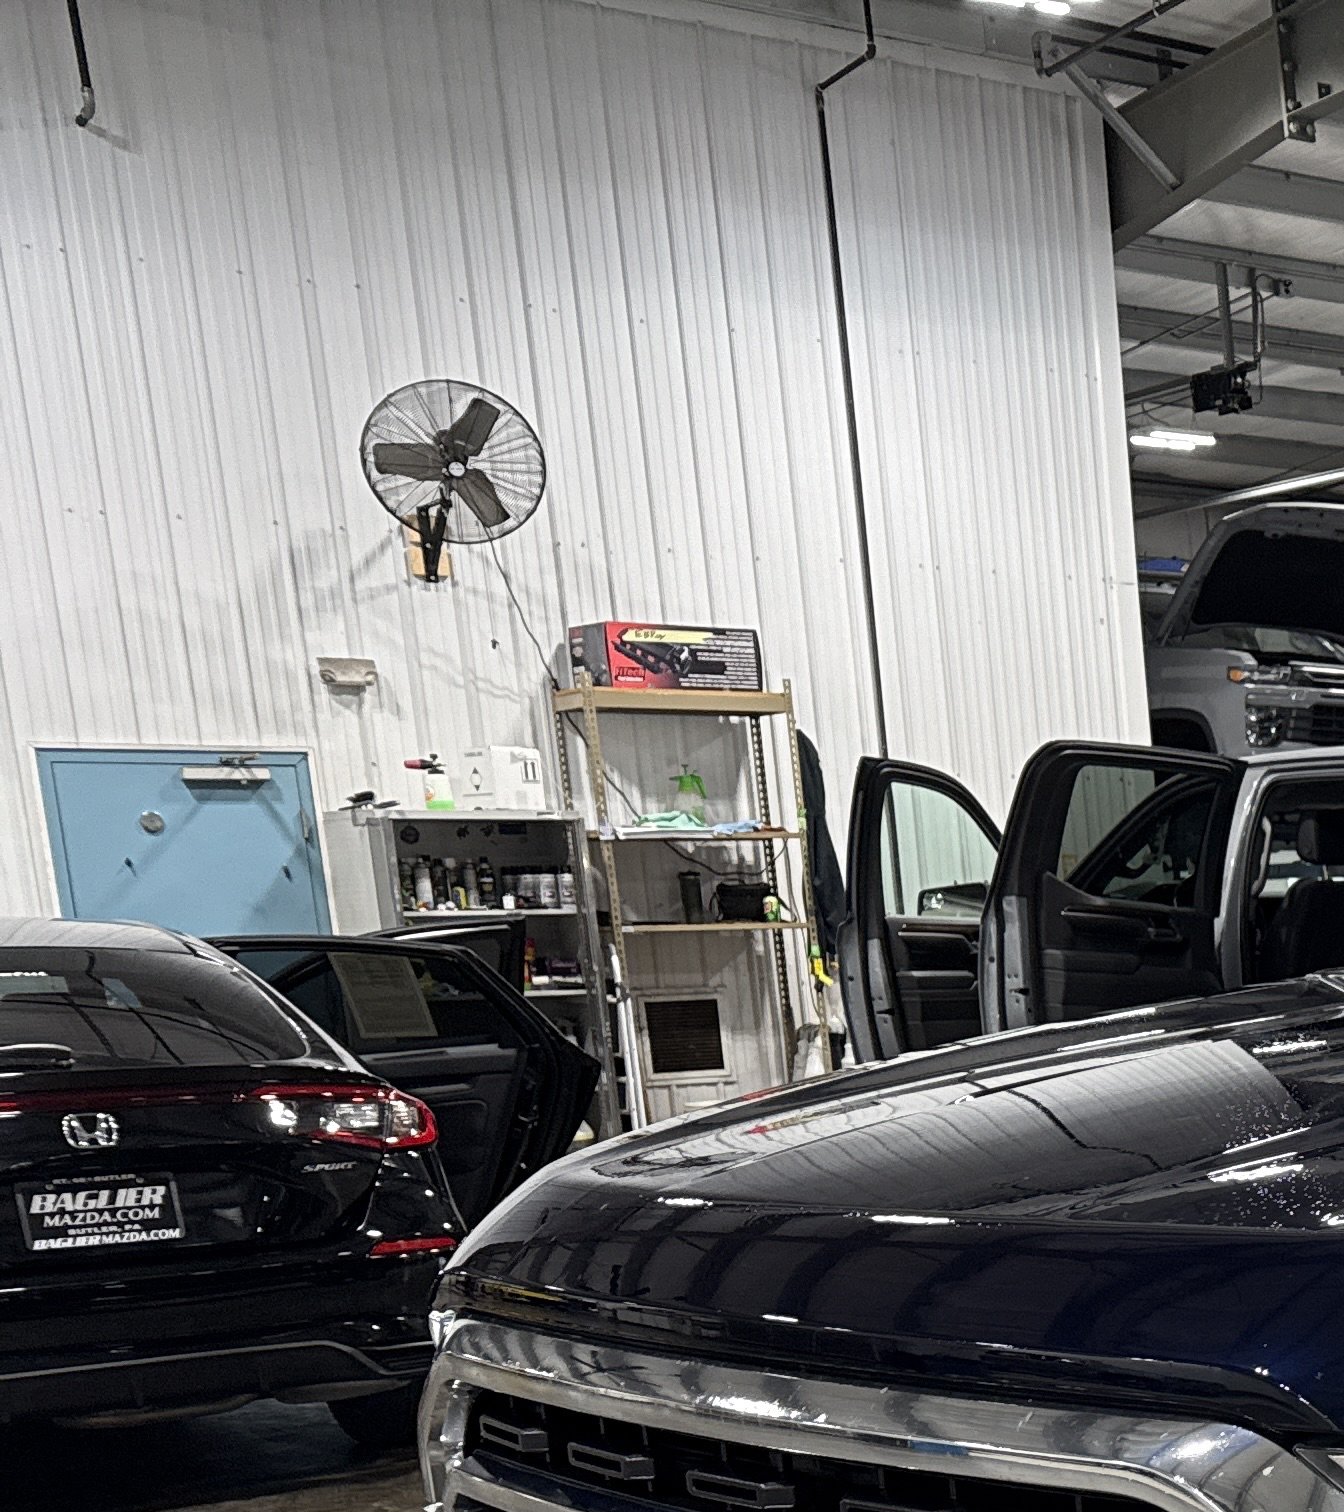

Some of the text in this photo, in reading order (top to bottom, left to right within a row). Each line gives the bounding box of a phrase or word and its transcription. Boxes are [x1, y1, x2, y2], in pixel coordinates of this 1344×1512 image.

[301, 1161, 358, 1173] SPORT
[29, 1185, 167, 1214] BAGLIER
[43, 1206, 161, 1228] MAZDA.COM
[124, 1223, 143, 1231] PA
[32, 1227, 181, 1251] BAGLIERMAZDA.COM
